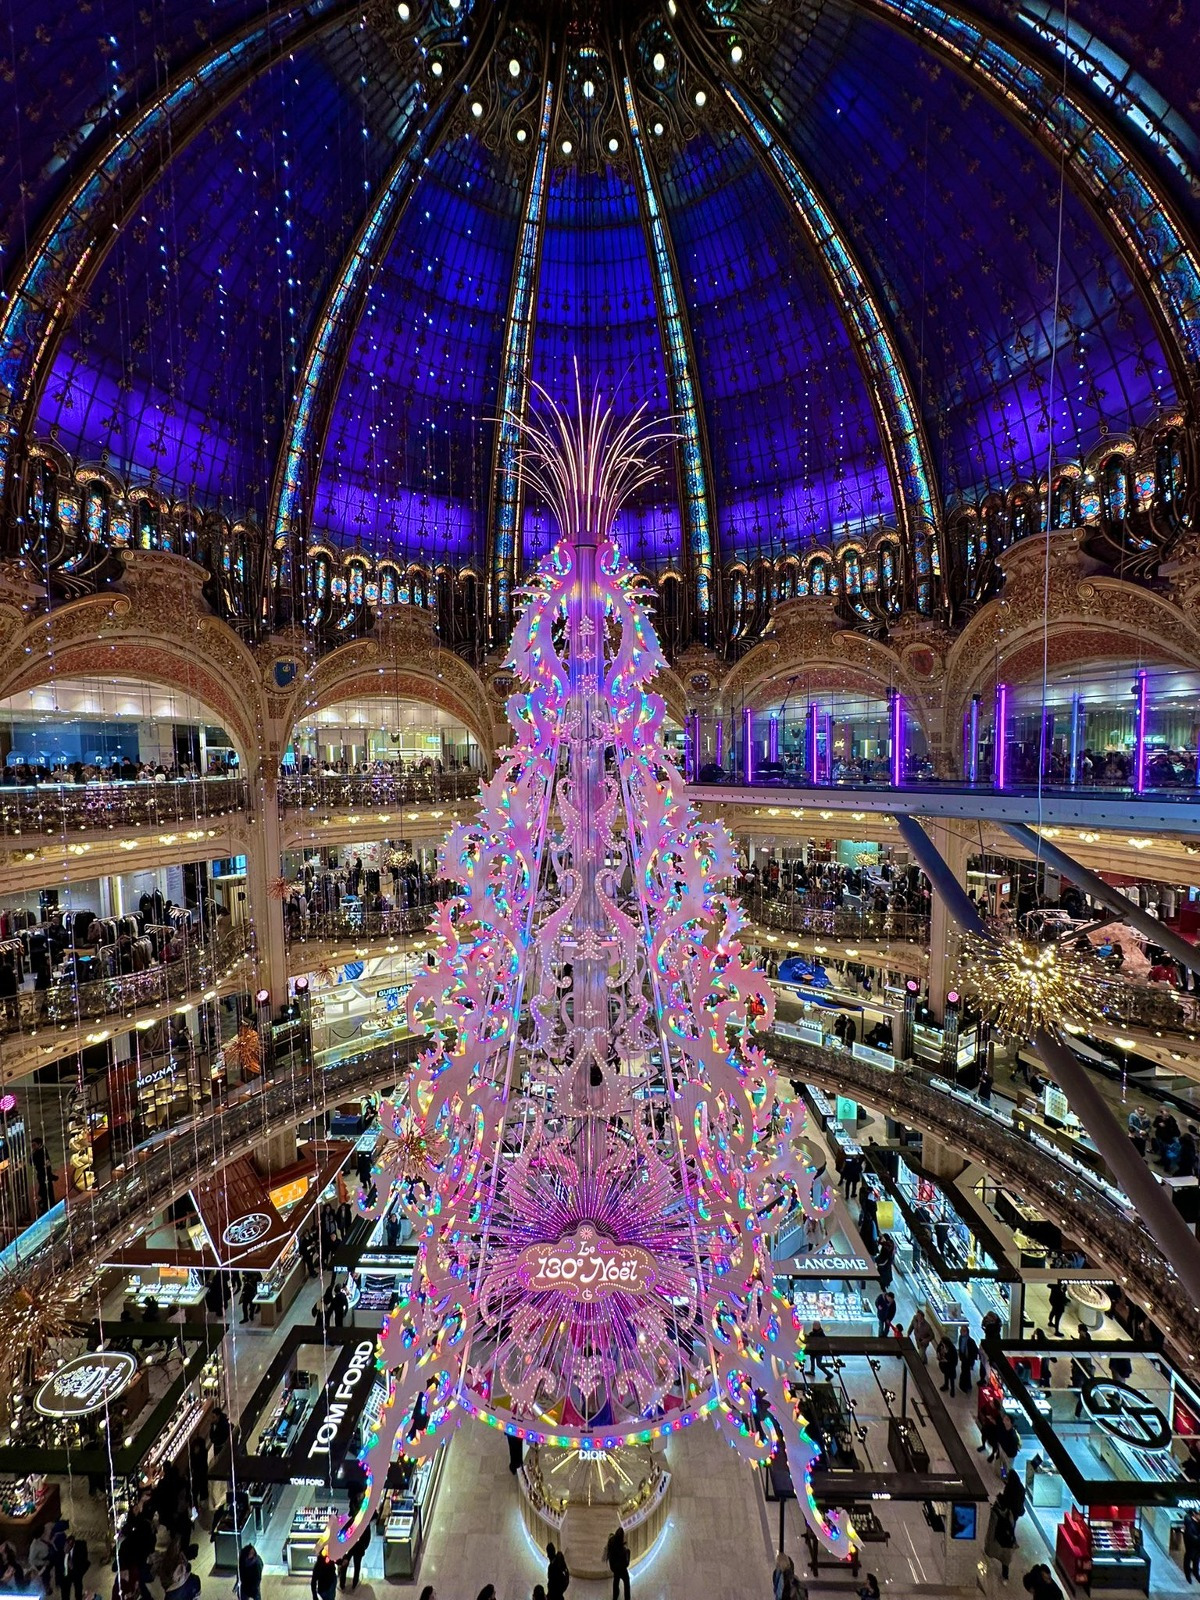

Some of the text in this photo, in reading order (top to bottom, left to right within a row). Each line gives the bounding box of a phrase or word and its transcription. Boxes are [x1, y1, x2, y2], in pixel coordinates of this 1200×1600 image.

[378, 985, 412, 997] GUERLAIN
[136, 1062, 178, 1088] MOYNAT
[577, 1241, 596, 1256] Le
[579, 1256, 639, 1283] Noël
[793, 1257, 869, 1270] LANCÔME
[307, 1340, 374, 1459] TOM FORD
[579, 1449, 608, 1461] DIOR
[289, 1478, 325, 1487] TOM FORD
